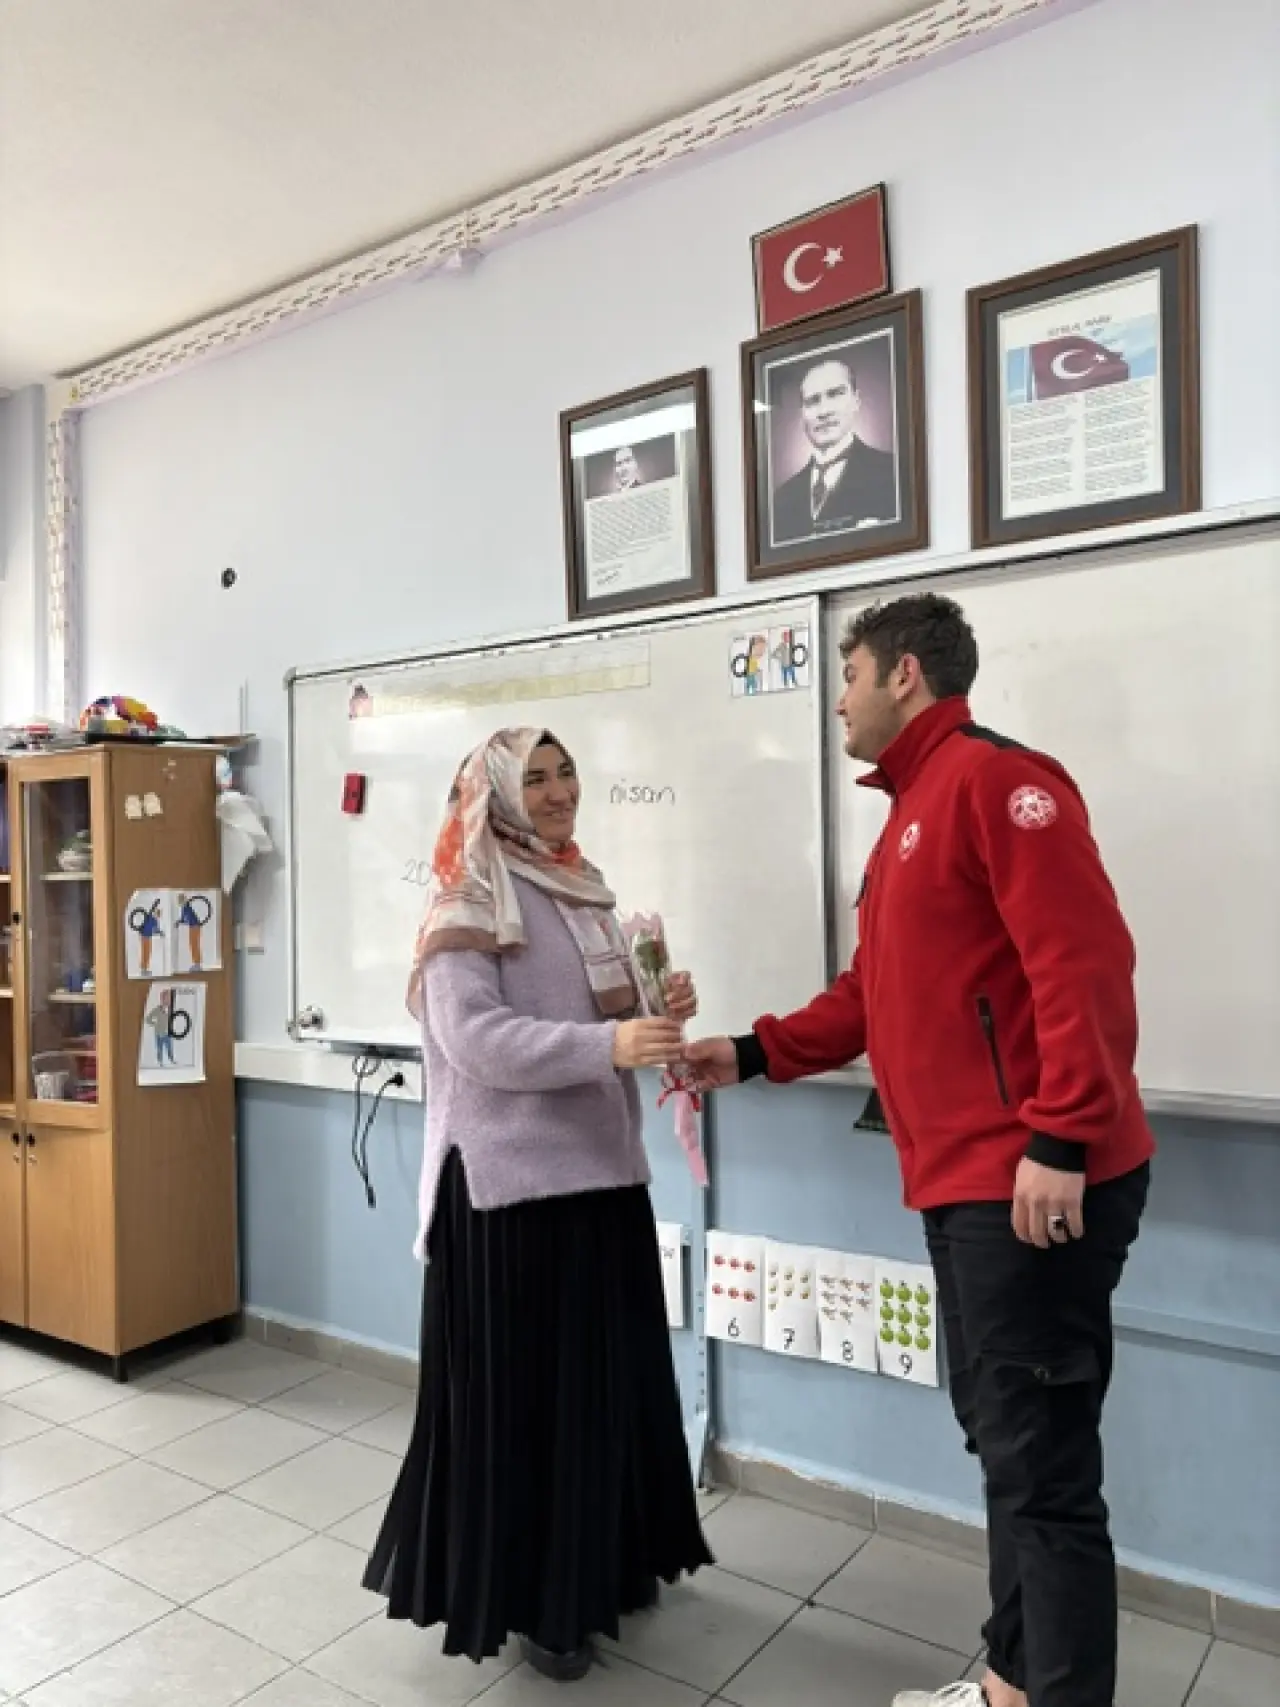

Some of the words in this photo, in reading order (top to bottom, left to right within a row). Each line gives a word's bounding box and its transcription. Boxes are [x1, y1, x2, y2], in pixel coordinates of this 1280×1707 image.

[609, 778, 675, 806] nisan
[167, 988, 192, 1040] b
[727, 1317, 740, 1339] 6
[783, 1327, 796, 1350] 7
[841, 1339, 854, 1363] 8
[899, 1352, 913, 1376] 9
